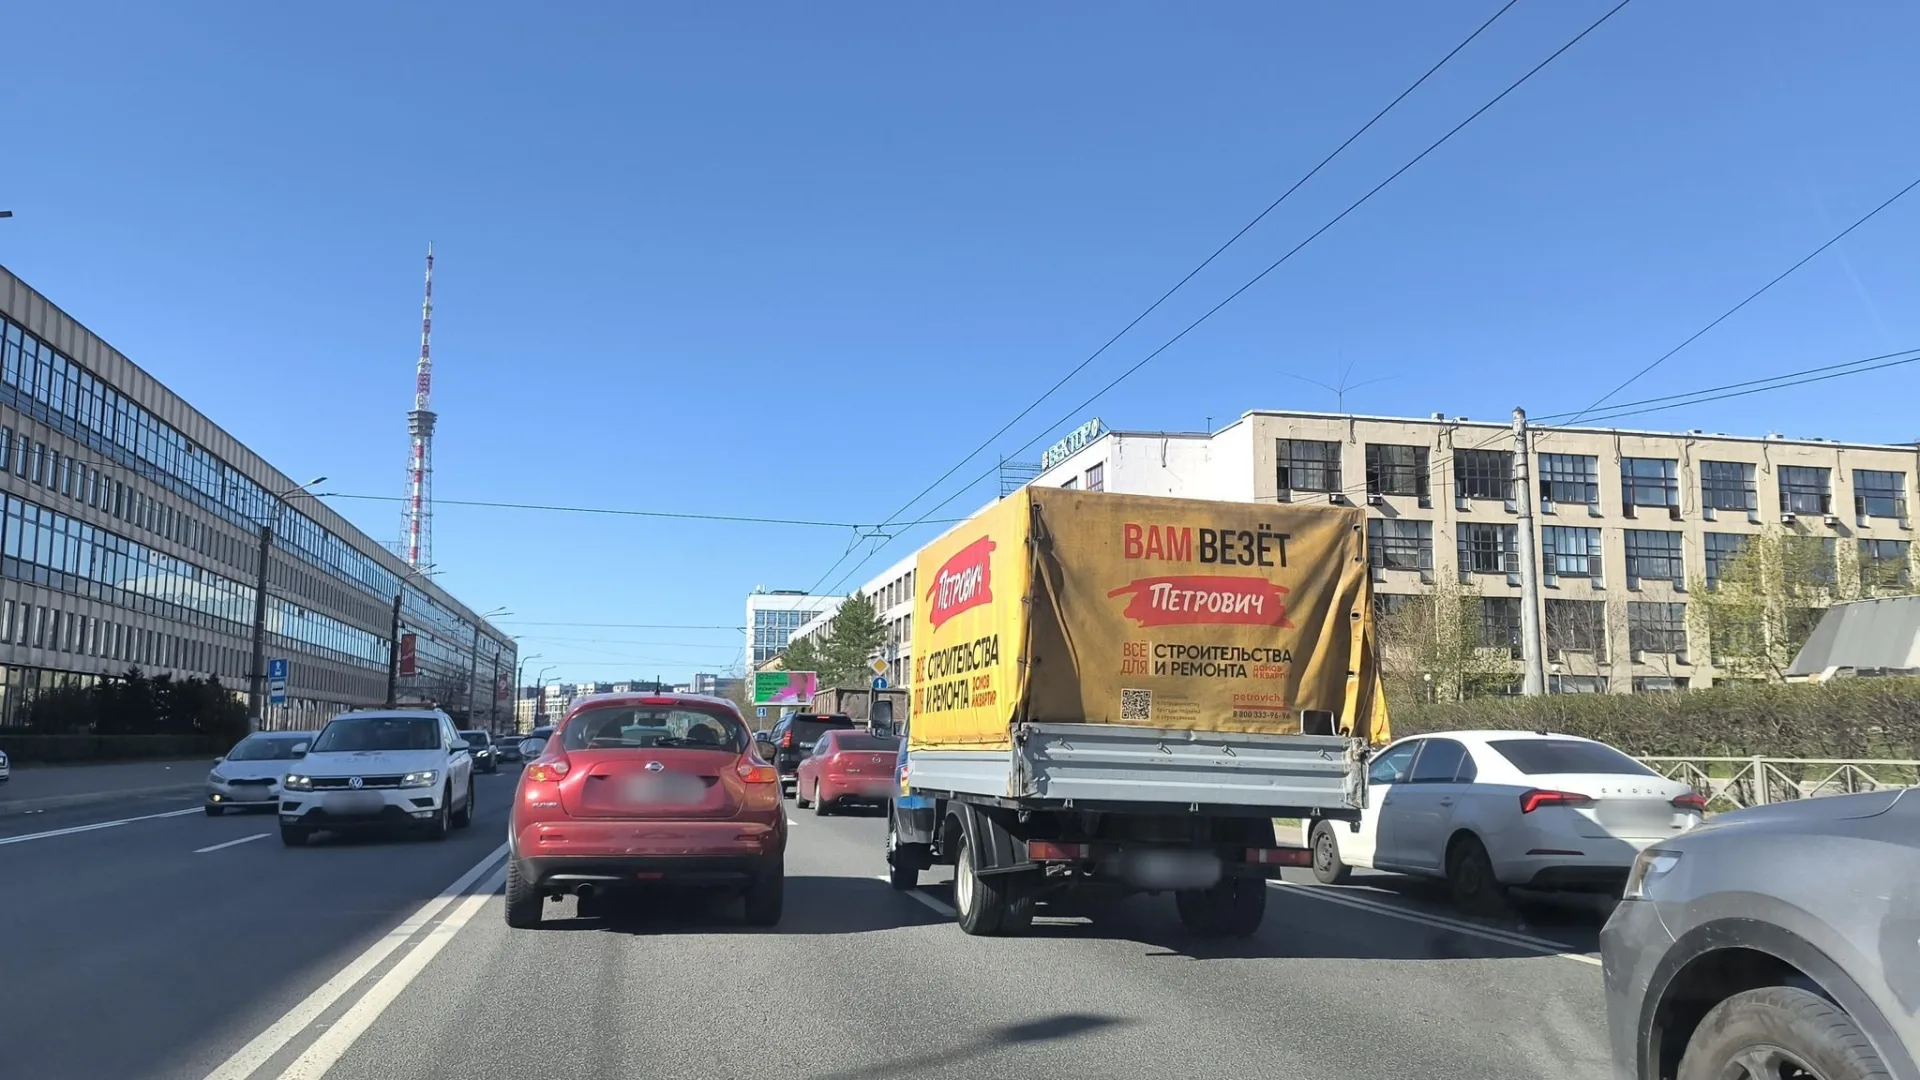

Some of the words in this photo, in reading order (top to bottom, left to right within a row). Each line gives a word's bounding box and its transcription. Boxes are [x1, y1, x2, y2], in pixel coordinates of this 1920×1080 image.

[1124, 523, 1192, 562] ВАМ
[1199, 523, 1291, 568] ВЕЗЁТ
[1149, 582, 1265, 615] ПЕТРОВИЧ
[927, 633, 999, 681] СТРОИТЕЛЬСТВА
[1123, 639, 1148, 658] ВСЁ
[1154, 643, 1293, 664] СТРОИТЕЛЬСТВА
[1120, 658, 1148, 676] ДЛЯ
[1154, 660, 1166, 676] И
[1171, 661, 1248, 679] РЕМОНТА
[926, 686, 933, 714] И
[933, 678, 970, 713] РЕМОНТА
[1239, 710, 1252, 718] 800
[1254, 711, 1291, 720] 333-96-96
